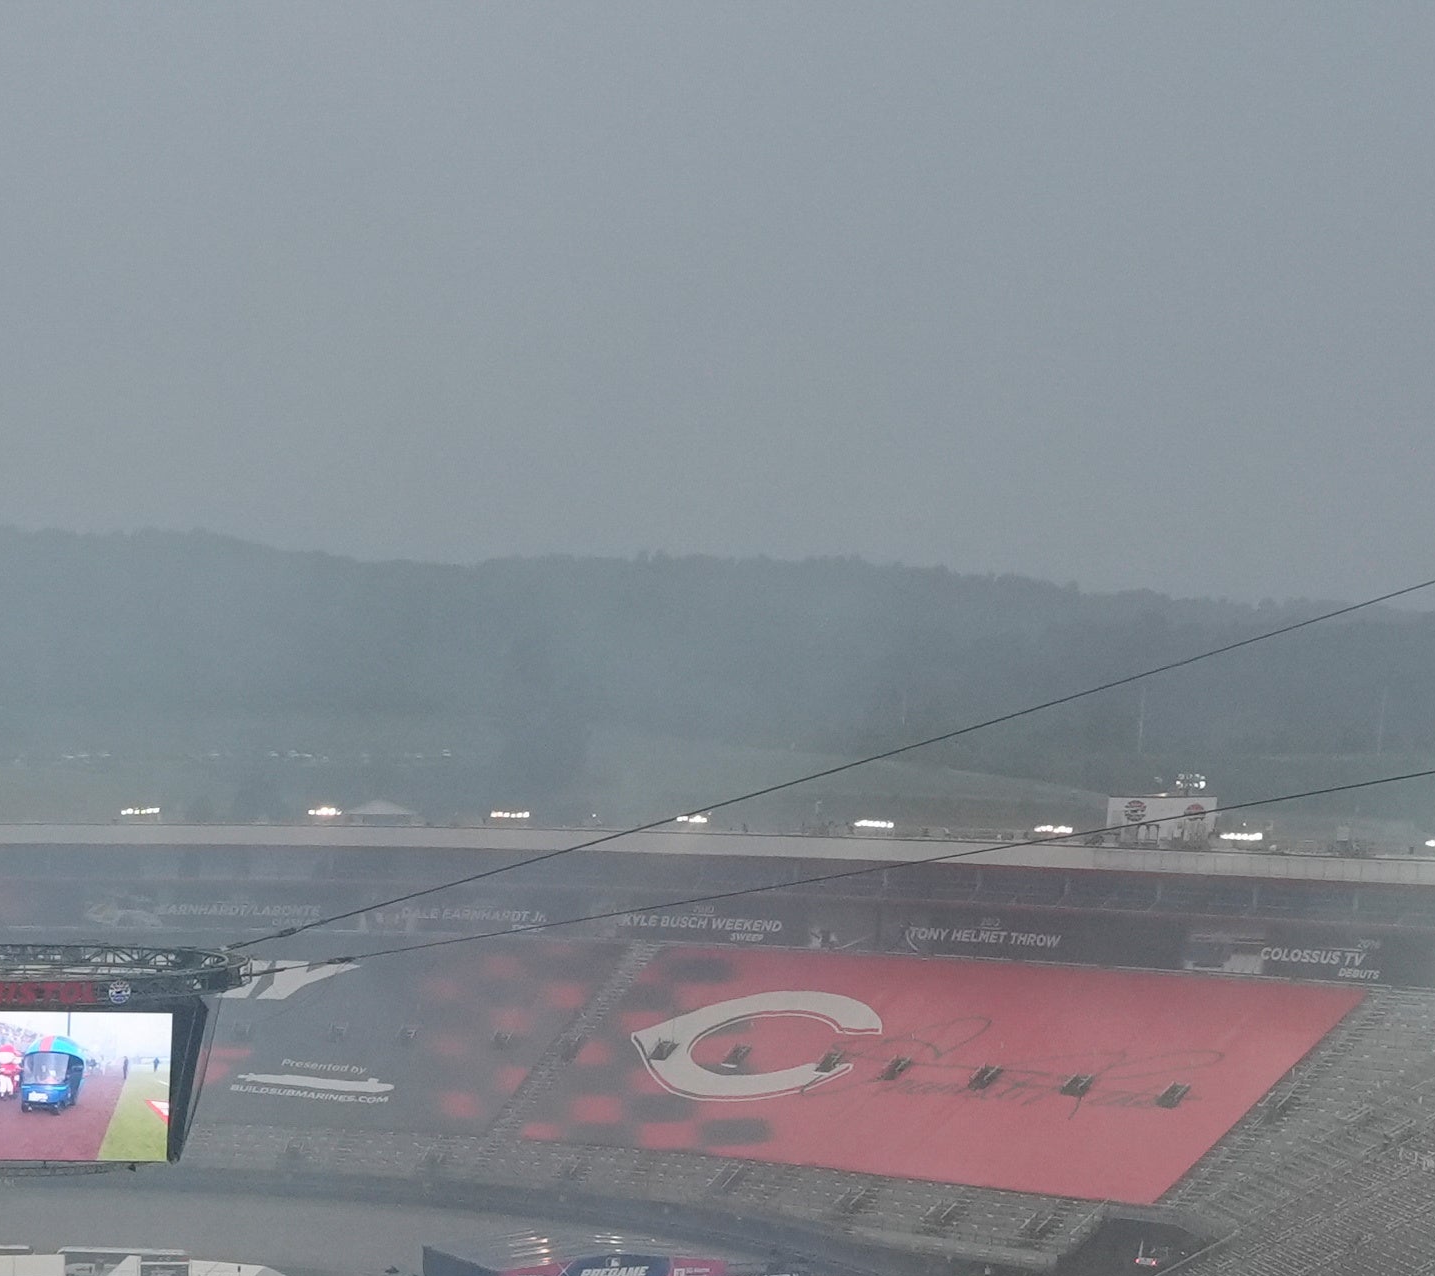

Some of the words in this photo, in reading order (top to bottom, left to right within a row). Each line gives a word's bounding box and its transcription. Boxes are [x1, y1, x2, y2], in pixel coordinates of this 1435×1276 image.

[441, 908, 529, 921] EARNHARDT
[620, 914, 659, 929] KYLE
[660, 915, 707, 930] BUSCH
[711, 918, 784, 934] WEEKEND
[729, 932, 764, 943] SWEEP
[909, 926, 949, 942] TONY
[951, 929, 1008, 945] HELMET
[1009, 932, 1061, 949] THROW
[1260, 948, 1341, 965] COLOSSUS
[1342, 952, 1368, 967] TV
[1338, 968, 1381, 980] DEBUTS
[281, 1060, 349, 1074] Presented
[350, 1067, 368, 1078] by
[230, 1085, 390, 1104] BUILDSUBMARINES.COM
